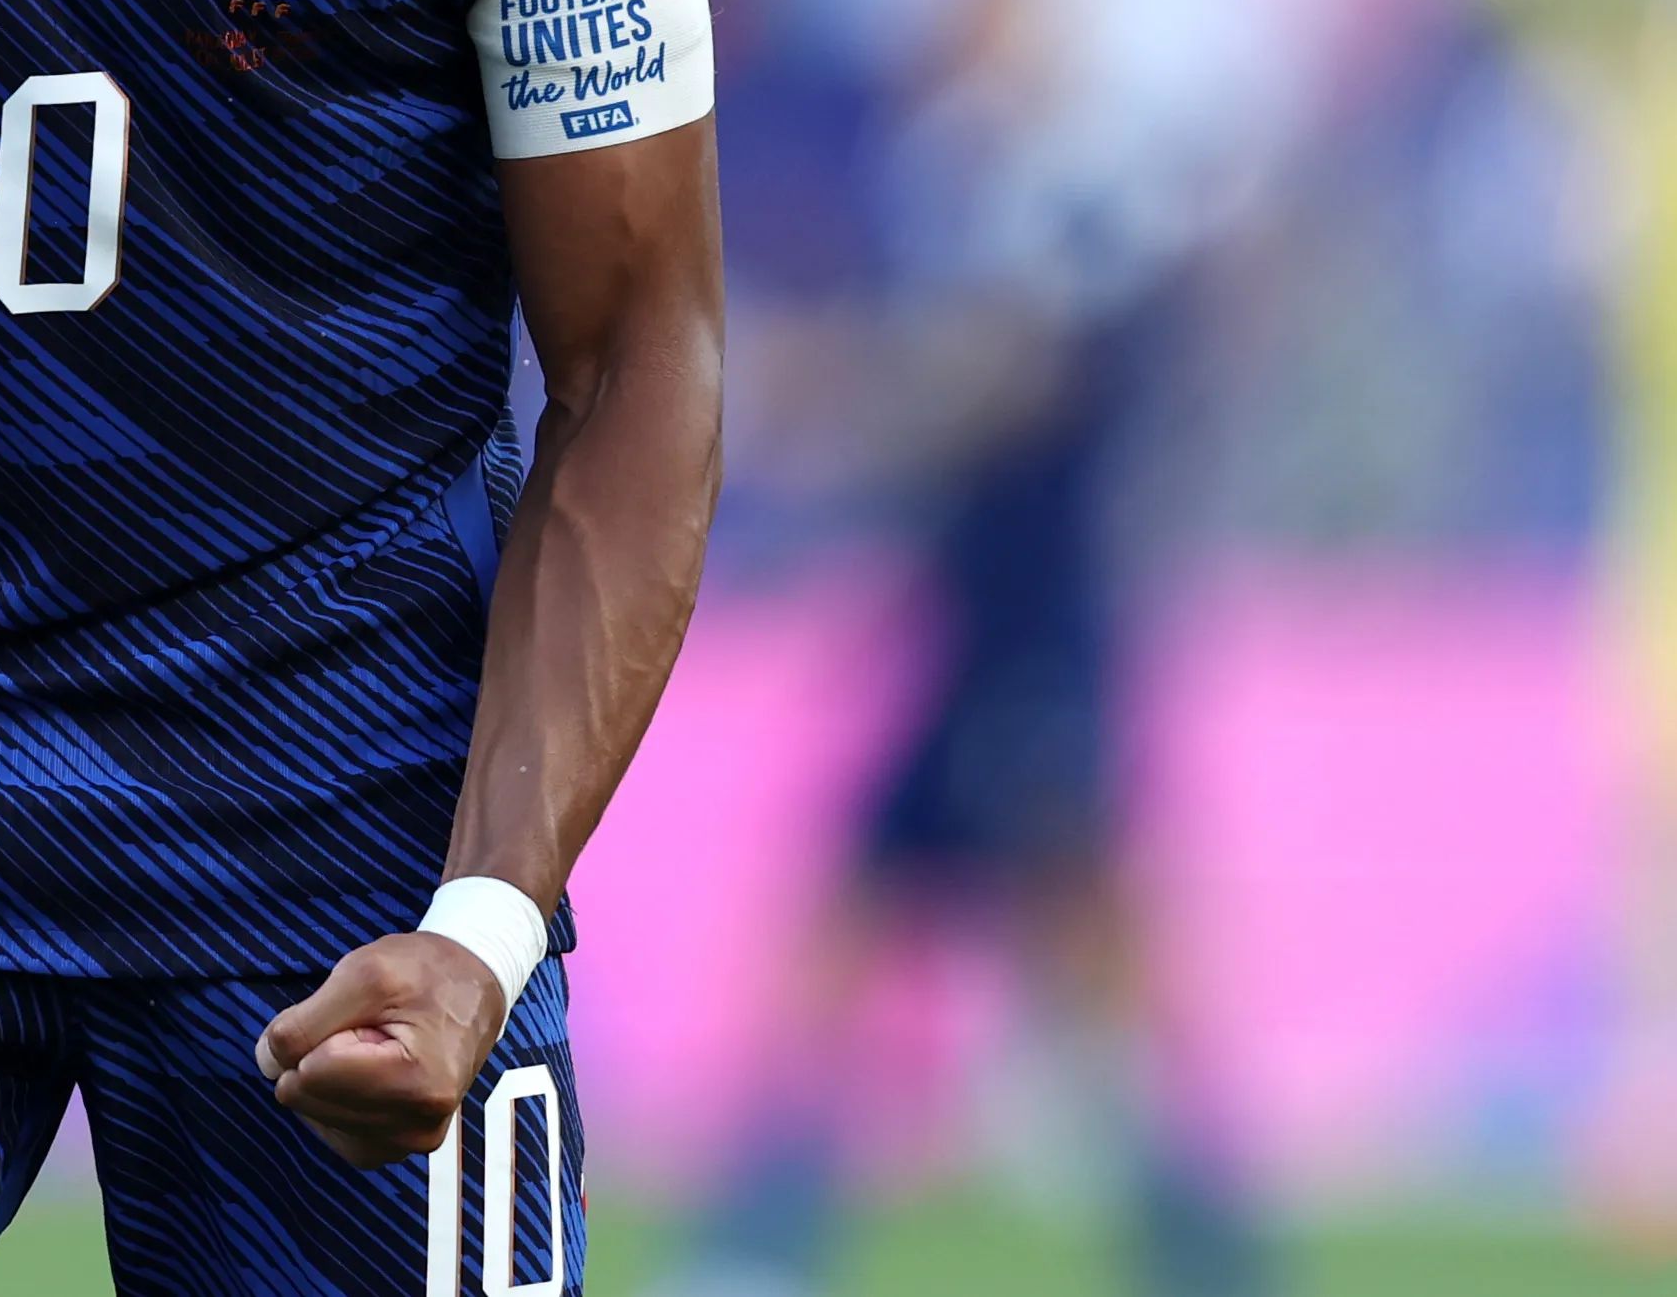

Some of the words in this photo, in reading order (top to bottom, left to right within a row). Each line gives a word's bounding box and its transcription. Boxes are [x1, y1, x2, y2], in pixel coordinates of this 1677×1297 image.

[501, 70, 566, 110] the
[574, 42, 665, 101] World
[569, 107, 629, 134] FIFA
